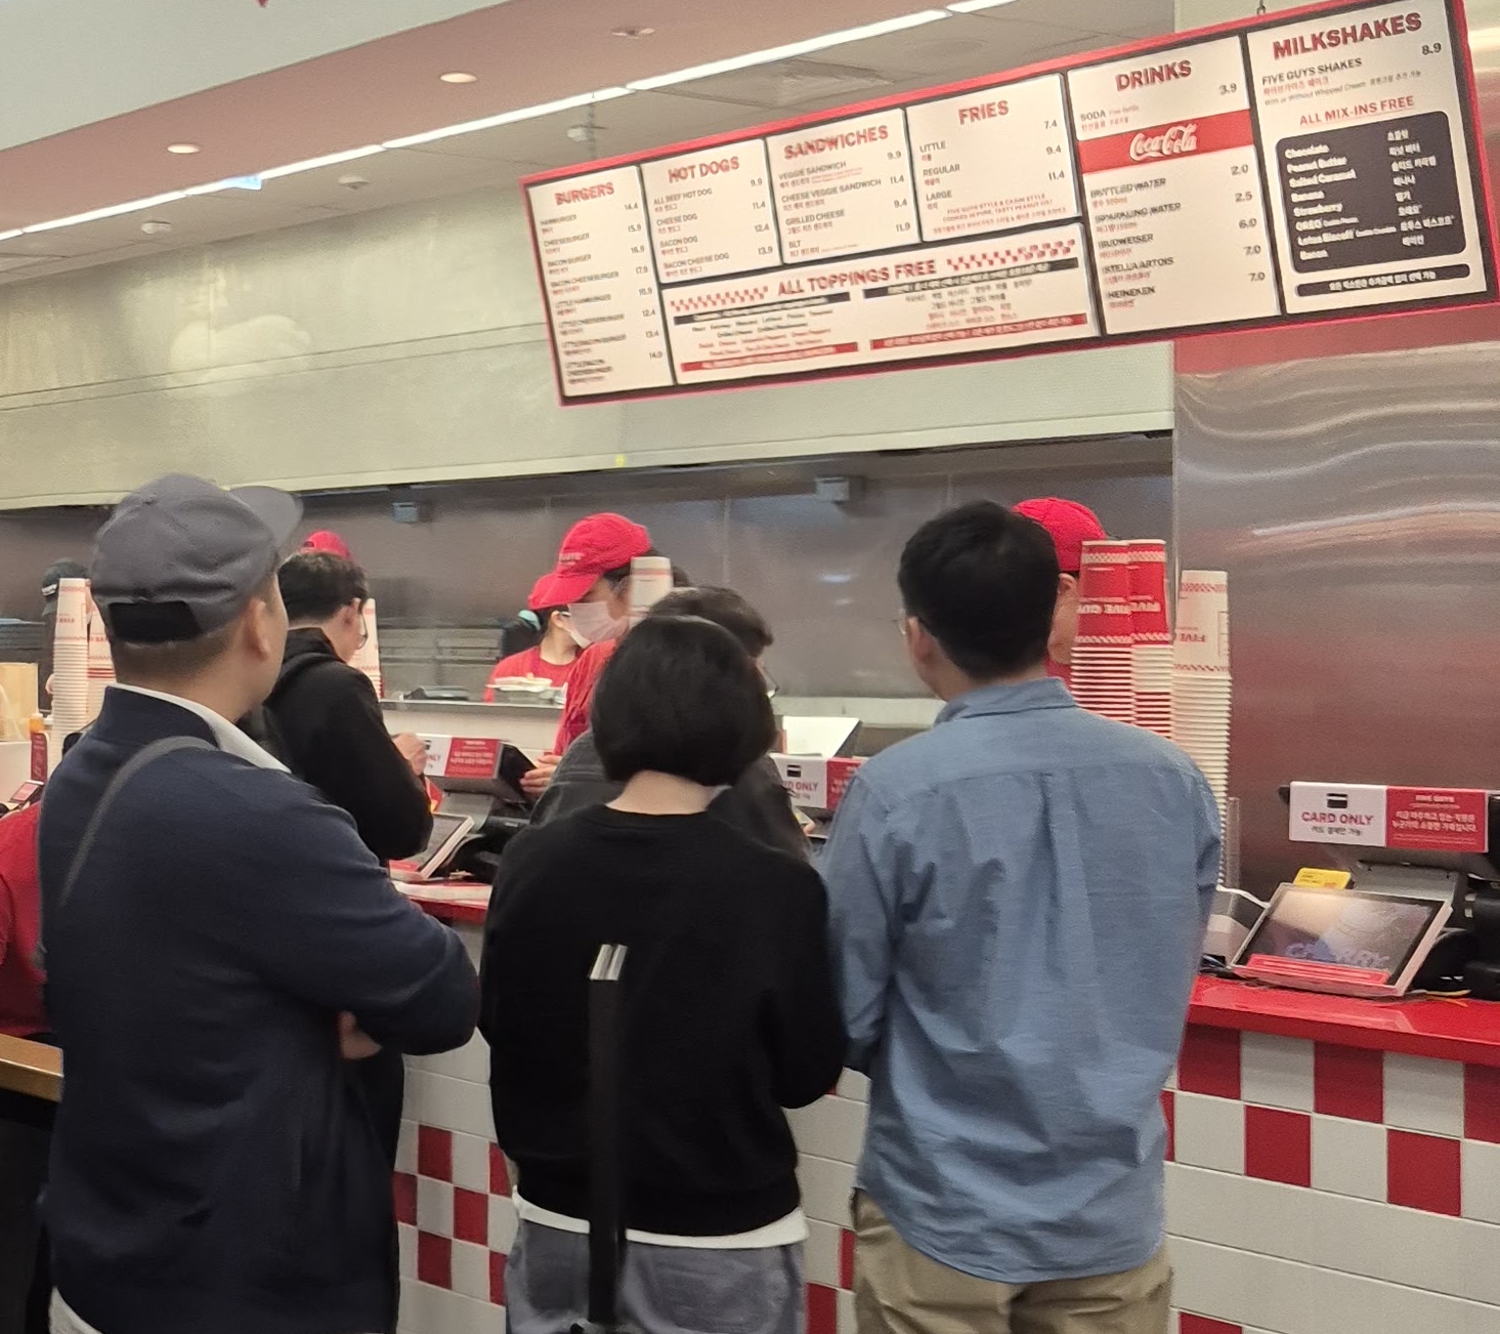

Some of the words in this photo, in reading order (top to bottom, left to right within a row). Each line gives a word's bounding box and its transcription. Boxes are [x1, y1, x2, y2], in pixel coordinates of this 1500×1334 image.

[1273, 12, 1422, 61] MILKSHAKES
[1421, 43, 1441, 55] 8.9
[1115, 60, 1192, 91] DRINKS
[1262, 73, 1284, 86] FIVE
[1287, 67, 1316, 80] GUYS
[1318, 58, 1362, 74] SHAKES
[1220, 83, 1237, 95] 3.9
[958, 100, 1009, 125] FRIES
[1080, 110, 1106, 121] SODA
[1300, 114, 1321, 126] ALL
[1325, 102, 1377, 121] MIX-INS
[1381, 95, 1414, 111] FREE
[1044, 120, 1057, 129] 7.4
[784, 125, 889, 160] SANDWICHES
[920, 141, 946, 153] LITTLE
[887, 151, 901, 159] 9.9
[1046, 145, 1061, 155] 9.4
[668, 165, 696, 183] HOT
[699, 156, 740, 177] DOGS
[779, 168, 804, 180] VEGGIE
[806, 161, 846, 175] SANDWICH
[923, 164, 960, 177] REGULAR
[1049, 170, 1065, 181] 11.4
[1231, 165, 1248, 175] 2.0
[751, 178, 762, 186] 9.9
[890, 175, 904, 184] 11.4
[1135, 177, 1166, 191] WATER
[555, 182, 614, 206] BURGERS
[666, 193, 682, 202] BEEF
[683, 191, 696, 199] HOT
[698, 188, 712, 197] DOG
[782, 191, 810, 203] CHEESE
[811, 186, 838, 197] VEGGIE
[839, 179, 881, 193] SANDWICH
[926, 190, 952, 202] LARGE
[1235, 191, 1252, 202] 2.5
[624, 203, 638, 211] 14.4
[752, 201, 766, 209] 11.4
[894, 199, 907, 208] 9.4
[786, 215, 815, 226] GRILLED
[816, 209, 845, 221] CHEESE
[1095, 208, 1148, 223] SPARKLING
[1150, 202, 1181, 216] WATER
[657, 216, 682, 226] CHEESE
[683, 213, 697, 222] DOG
[1239, 218, 1257, 229] 6.0
[628, 224, 642, 233] 15.9
[754, 224, 769, 232] 12.4
[896, 222, 910, 232] 11.9
[660, 238, 682, 248] BACON
[684, 236, 698, 244] DOG
[789, 240, 801, 248] BLT
[1098, 234, 1153, 249] BUDWEISER
[758, 246, 773, 255] 13.9
[1245, 245, 1261, 256] 7.0
[664, 261, 686, 269] BACON
[688, 256, 713, 267] CHEESE
[714, 252, 729, 261] DOG
[1102, 262, 1137, 273] STELLA
[1139, 257, 1174, 269] ARTOIS
[778, 279, 804, 296] ALL
[807, 267, 890, 292] TOPPINGS
[894, 260, 937, 280] FREE
[1249, 272, 1265, 282] 7.0
[1106, 287, 1156, 299] HEINEKEN
[642, 309, 655, 317] 12.4
[646, 330, 659, 338] 13.4
[796, 781, 819, 792] ONLY
[1301, 812, 1335, 824] CARD
[1340, 814, 1374, 825] ONLY
